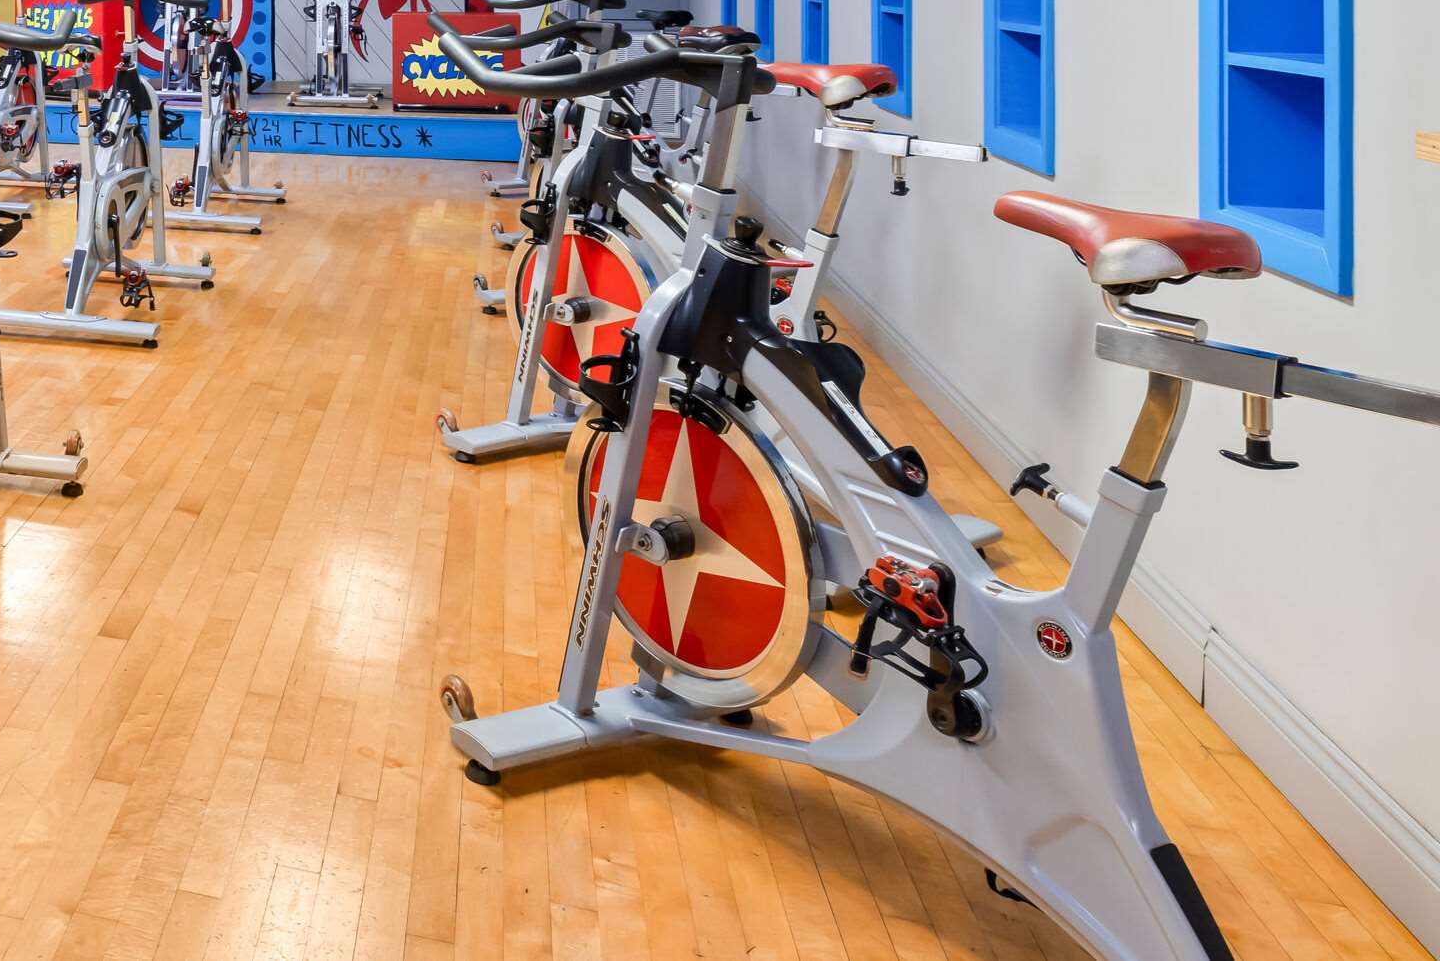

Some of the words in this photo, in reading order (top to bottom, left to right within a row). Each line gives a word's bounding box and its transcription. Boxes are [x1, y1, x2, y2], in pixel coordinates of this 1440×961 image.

[262, 118, 280, 134] 24
[293, 120, 403, 149] FITNESS
[264, 134, 282, 148] HR
[575, 495, 611, 652] SCHWINN
